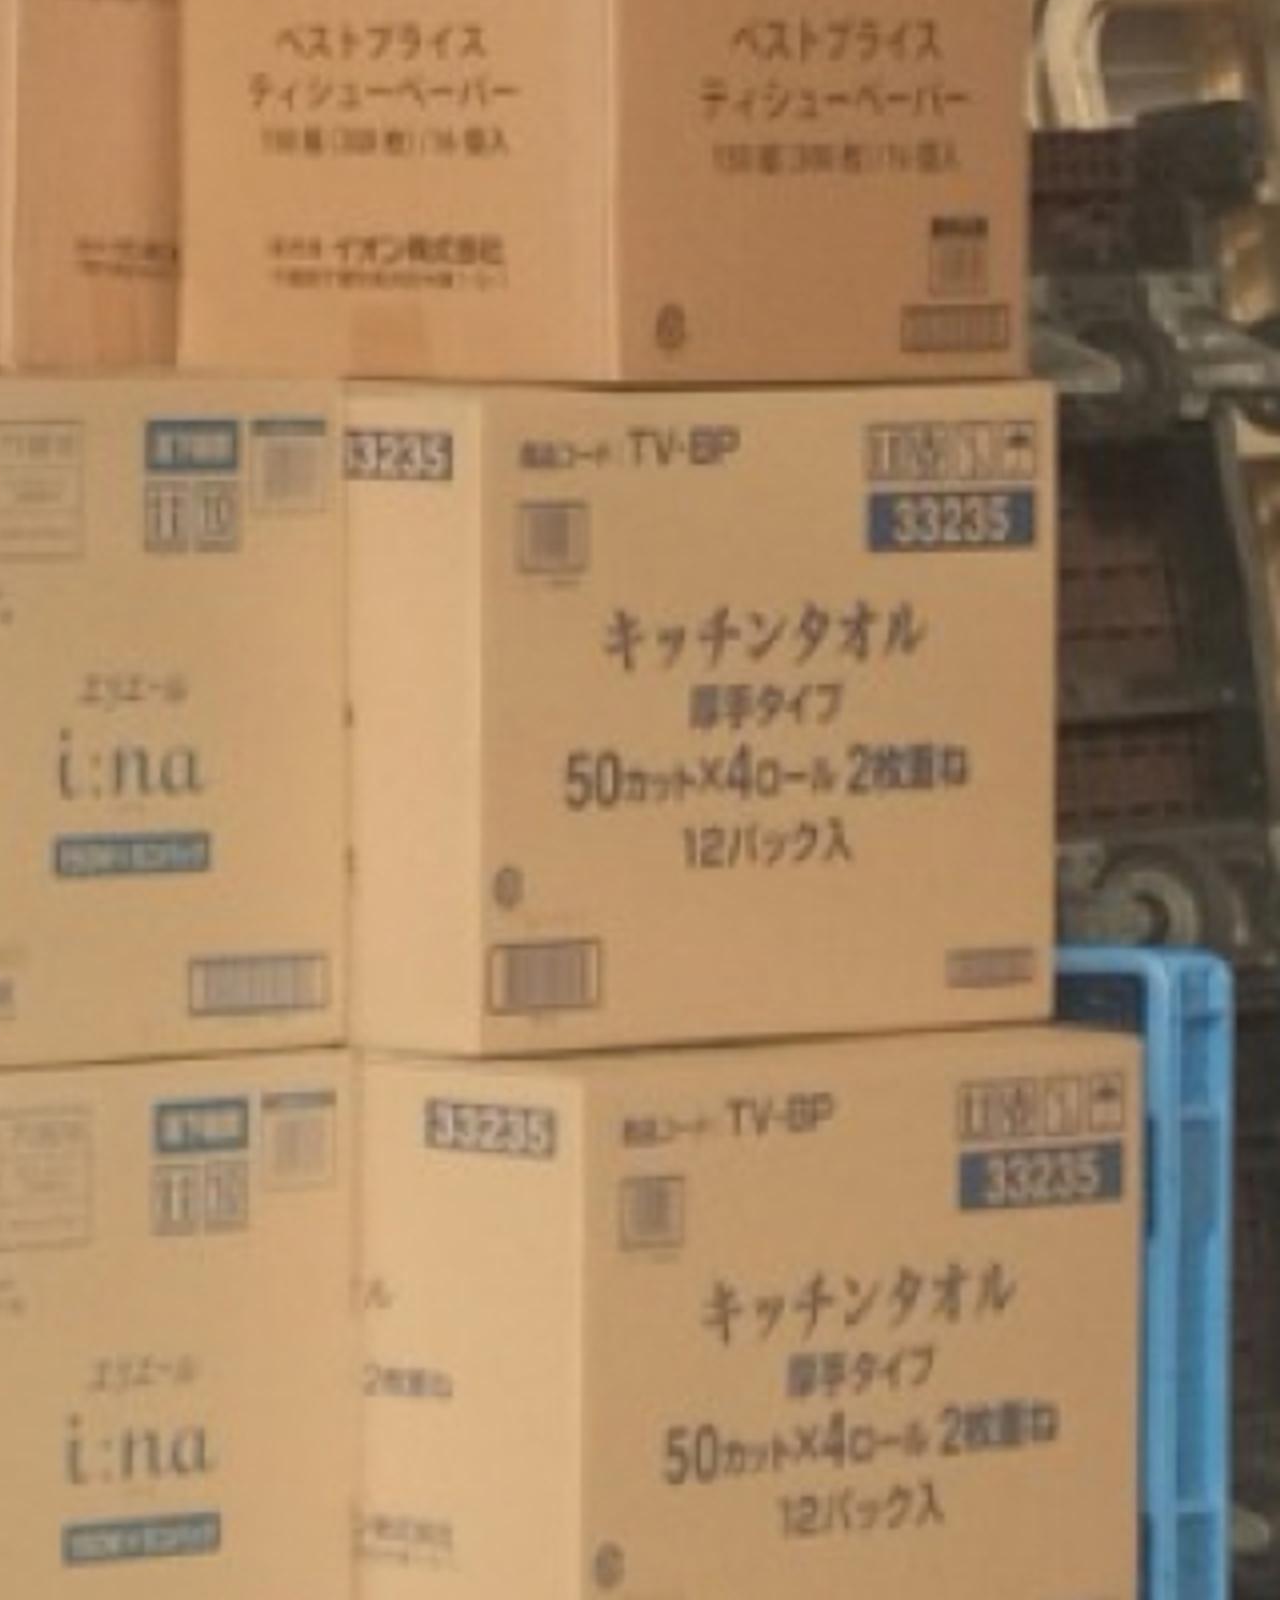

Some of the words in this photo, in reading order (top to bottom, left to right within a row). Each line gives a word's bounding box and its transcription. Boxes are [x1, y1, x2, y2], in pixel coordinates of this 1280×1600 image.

[894, 502, 1009, 543] 33235
[604, 601, 928, 671] キッチンタオル
[57, 730, 204, 801] i:na
[684, 819, 851, 869] 12パック入
[431, 1104, 549, 1154] 33235
[986, 1155, 1099, 1200] 33235
[701, 1262, 1018, 1346] キッチンタオル
[64, 1415, 213, 1485] i:na
[779, 1484, 944, 1538] 12パック入
